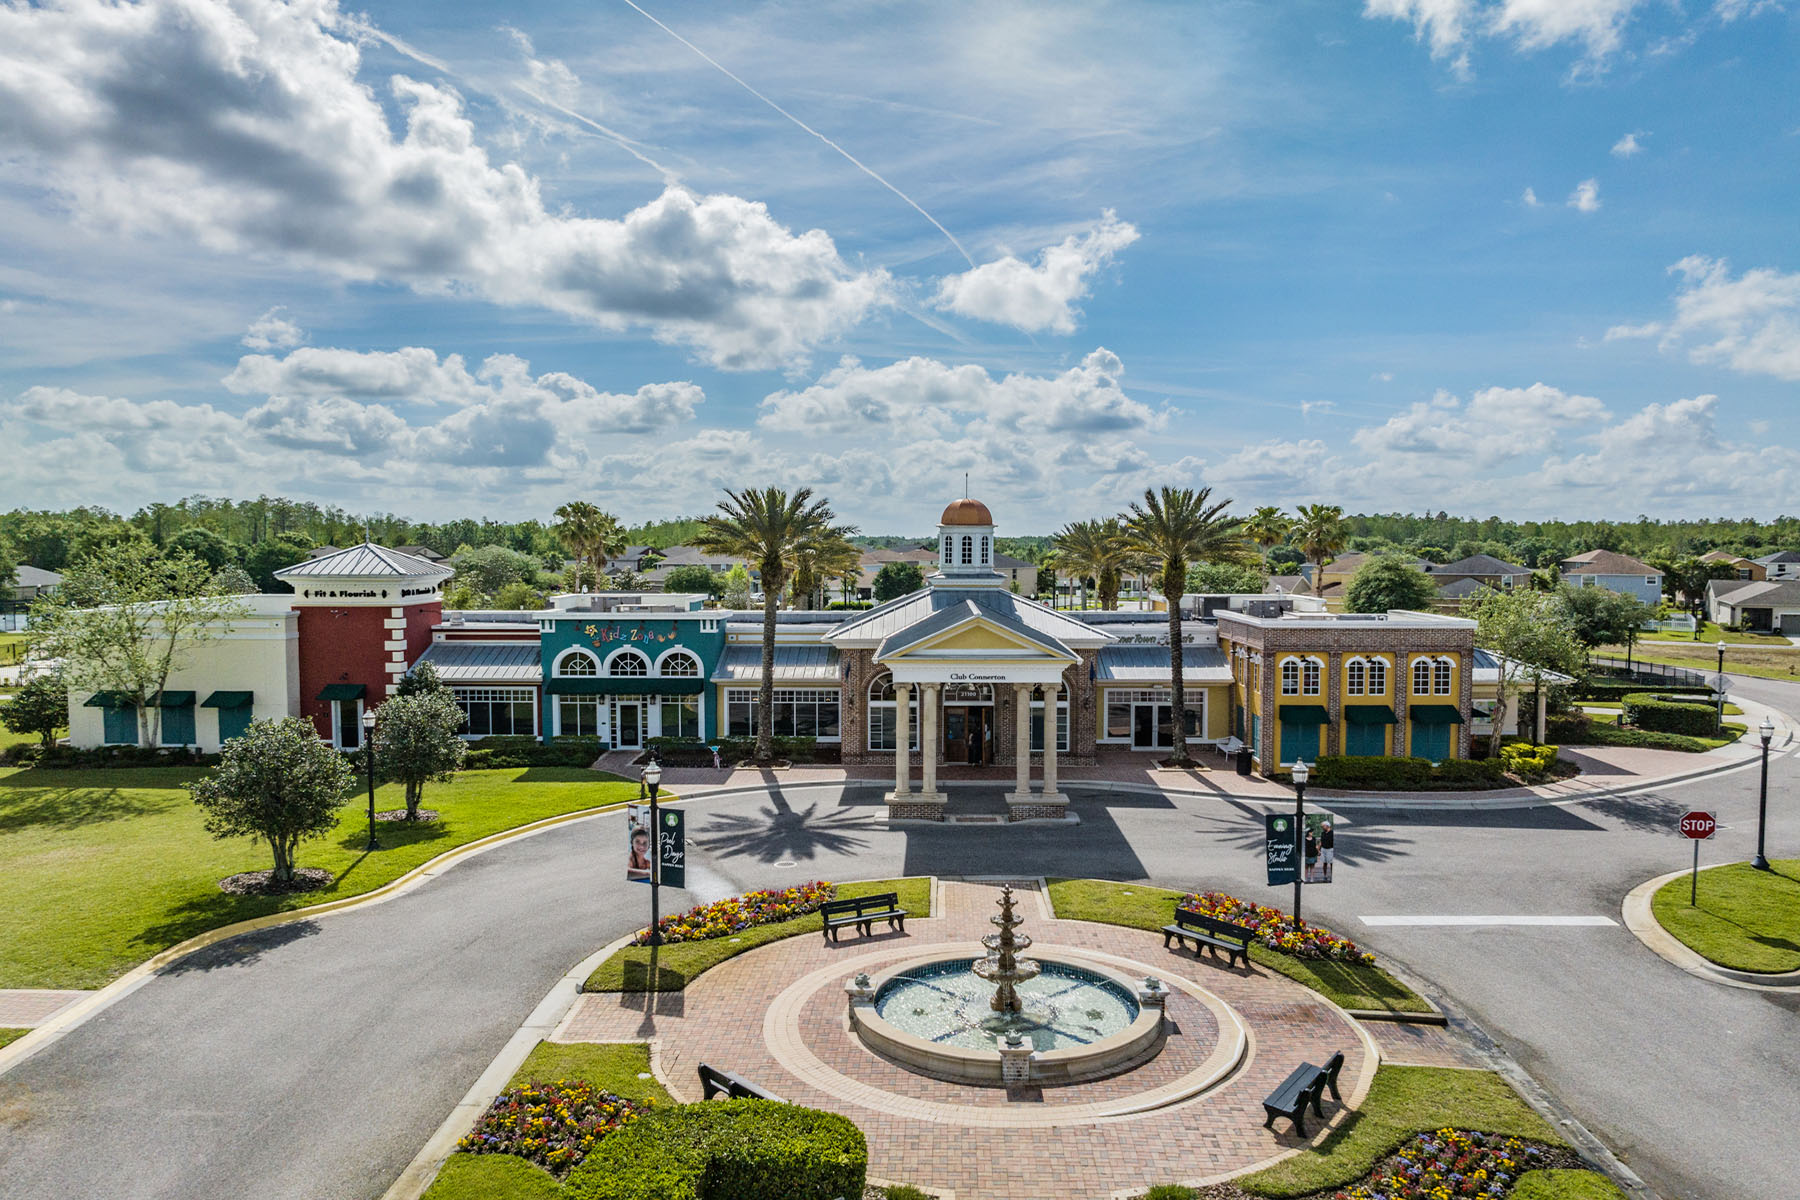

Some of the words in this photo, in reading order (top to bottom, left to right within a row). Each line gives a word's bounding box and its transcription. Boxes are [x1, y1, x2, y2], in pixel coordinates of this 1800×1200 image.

[315, 590, 326, 598] Fit
[329, 590, 337, 598] &
[340, 590, 376, 598] Flourish
[600, 626, 626, 642] Kidz
[631, 629, 654, 644] Zone
[1135, 634, 1156, 643] Town
[1182, 634, 1194, 643] afe
[1682, 820, 1714, 831] STOP
[660, 832, 676, 845] Pool
[664, 845, 684, 864] Days
